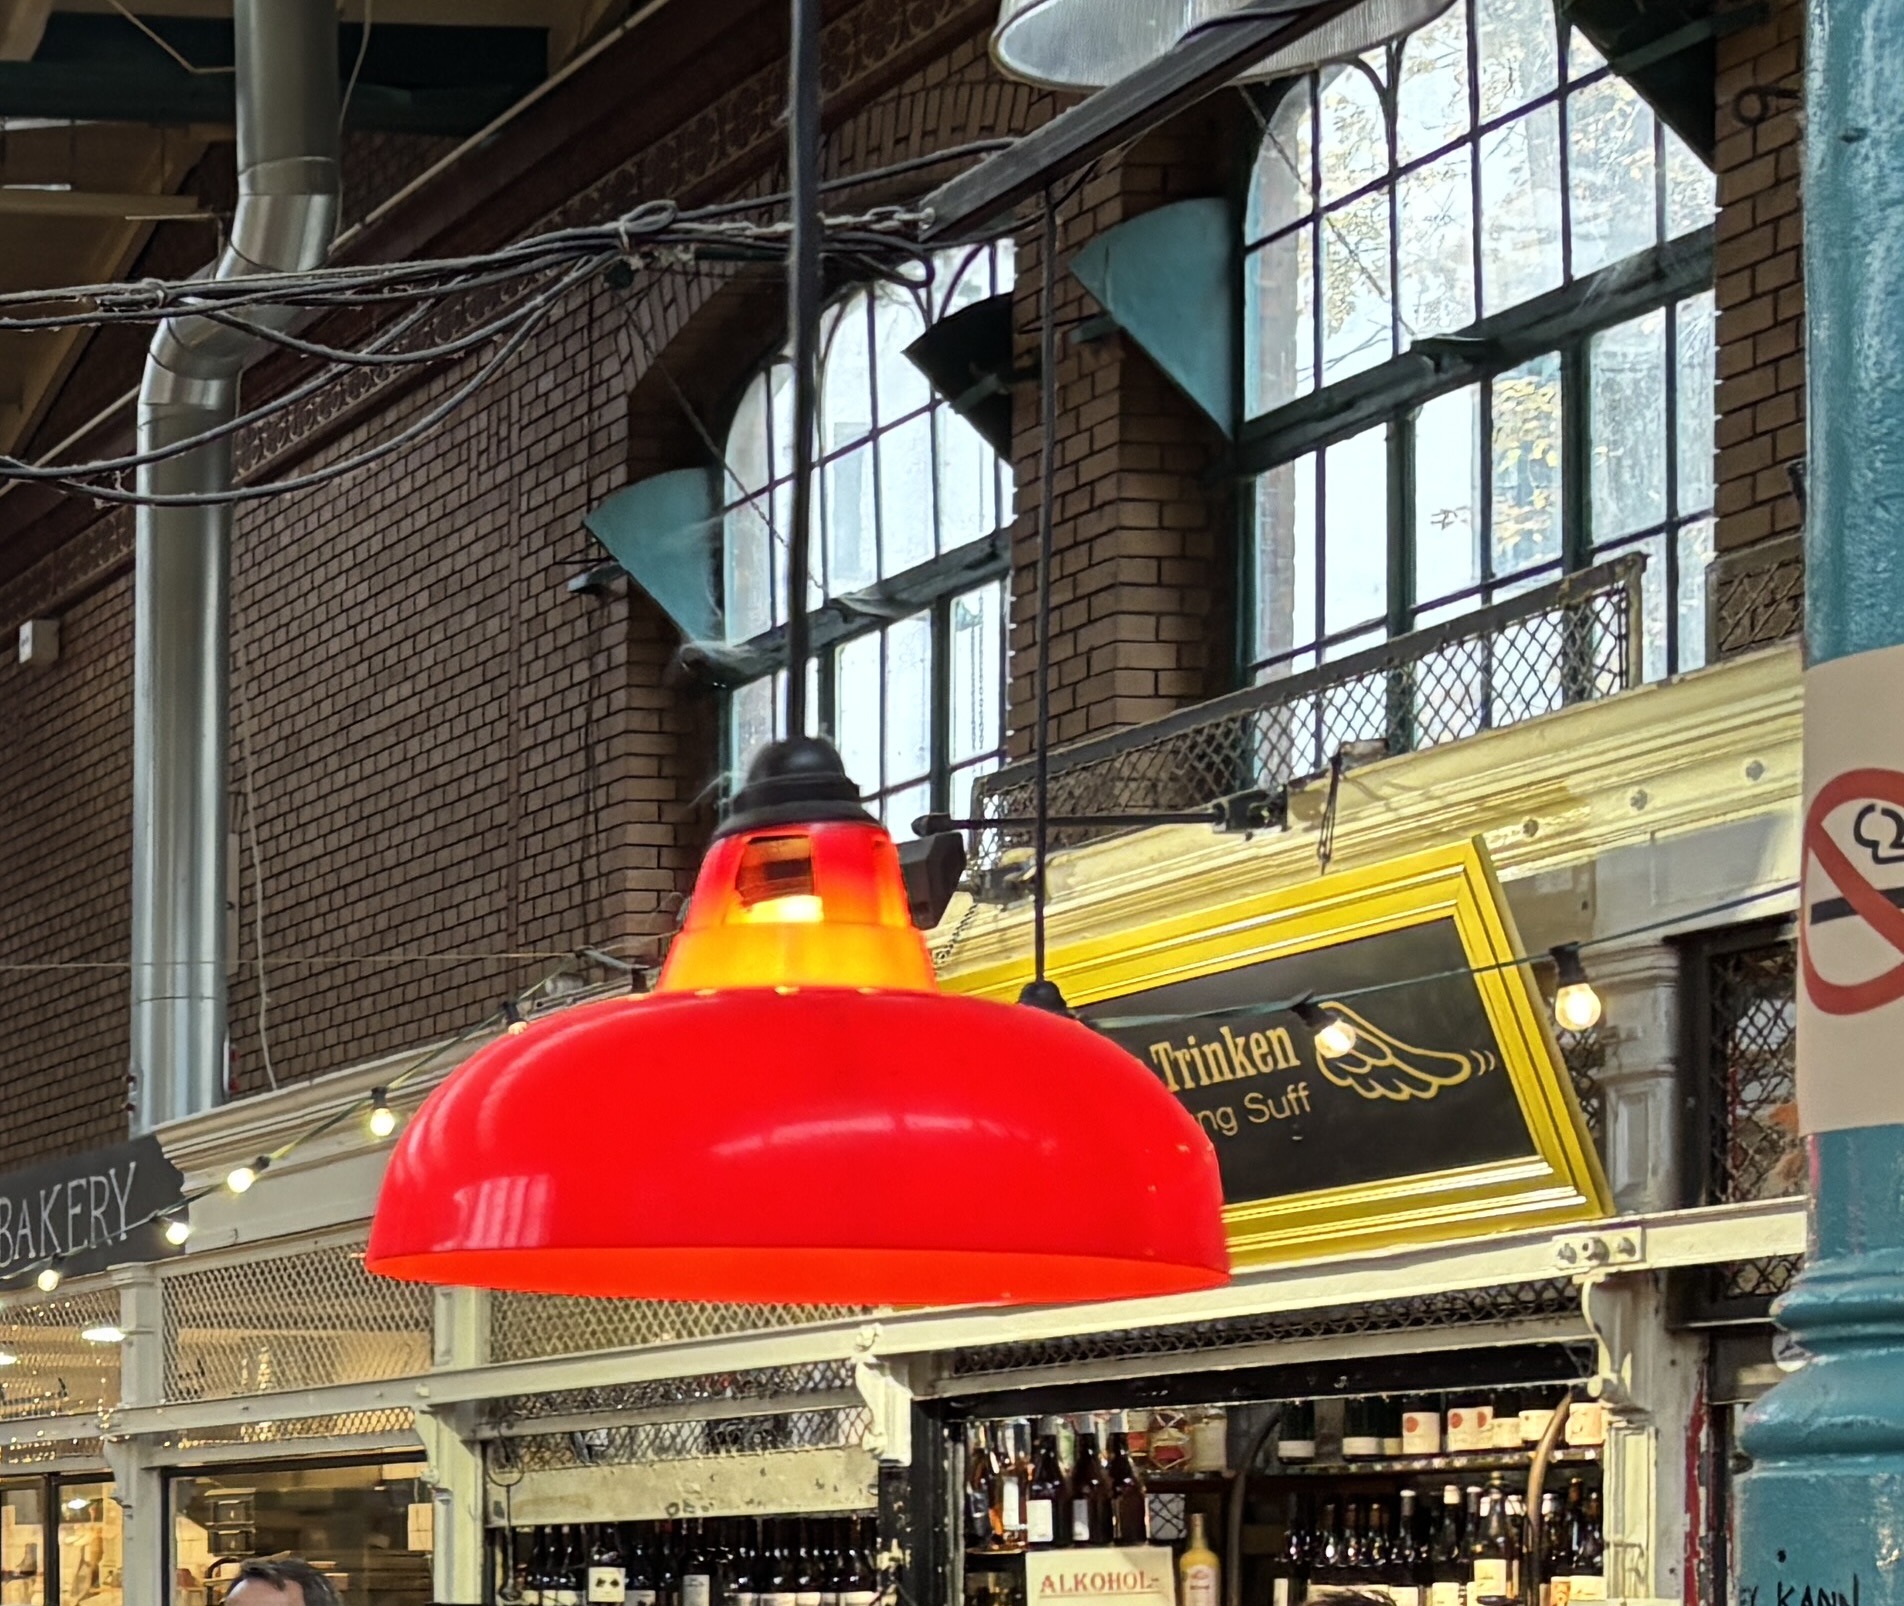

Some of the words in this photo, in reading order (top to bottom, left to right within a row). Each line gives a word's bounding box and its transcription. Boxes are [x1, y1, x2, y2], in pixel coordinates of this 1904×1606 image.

[1149, 1026, 1301, 1093] Trinken
[1197, 1106, 1239, 1137] ng
[1244, 1081, 1311, 1124] Suff
[1040, 1570, 1160, 1594] ALKOHOL-
